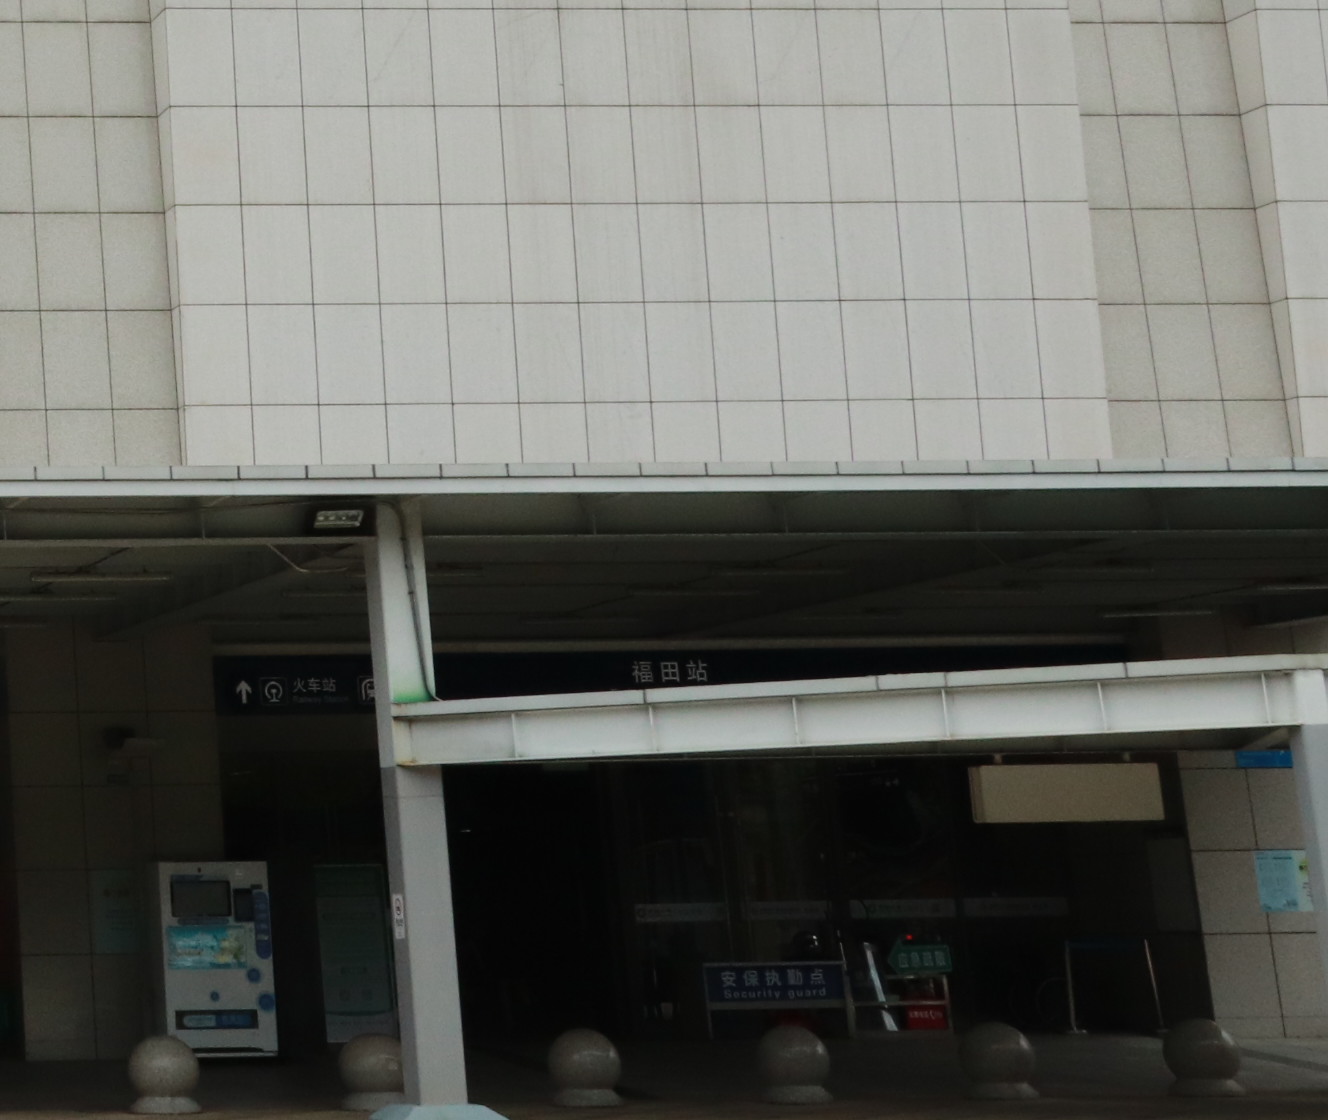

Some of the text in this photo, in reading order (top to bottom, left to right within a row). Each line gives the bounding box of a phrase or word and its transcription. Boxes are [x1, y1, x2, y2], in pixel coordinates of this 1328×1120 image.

[632, 658, 709, 683] 福田站
[293, 677, 337, 693] 火车站
[721, 967, 827, 988] 安保执勤点
[724, 987, 827, 1000] Security guard
